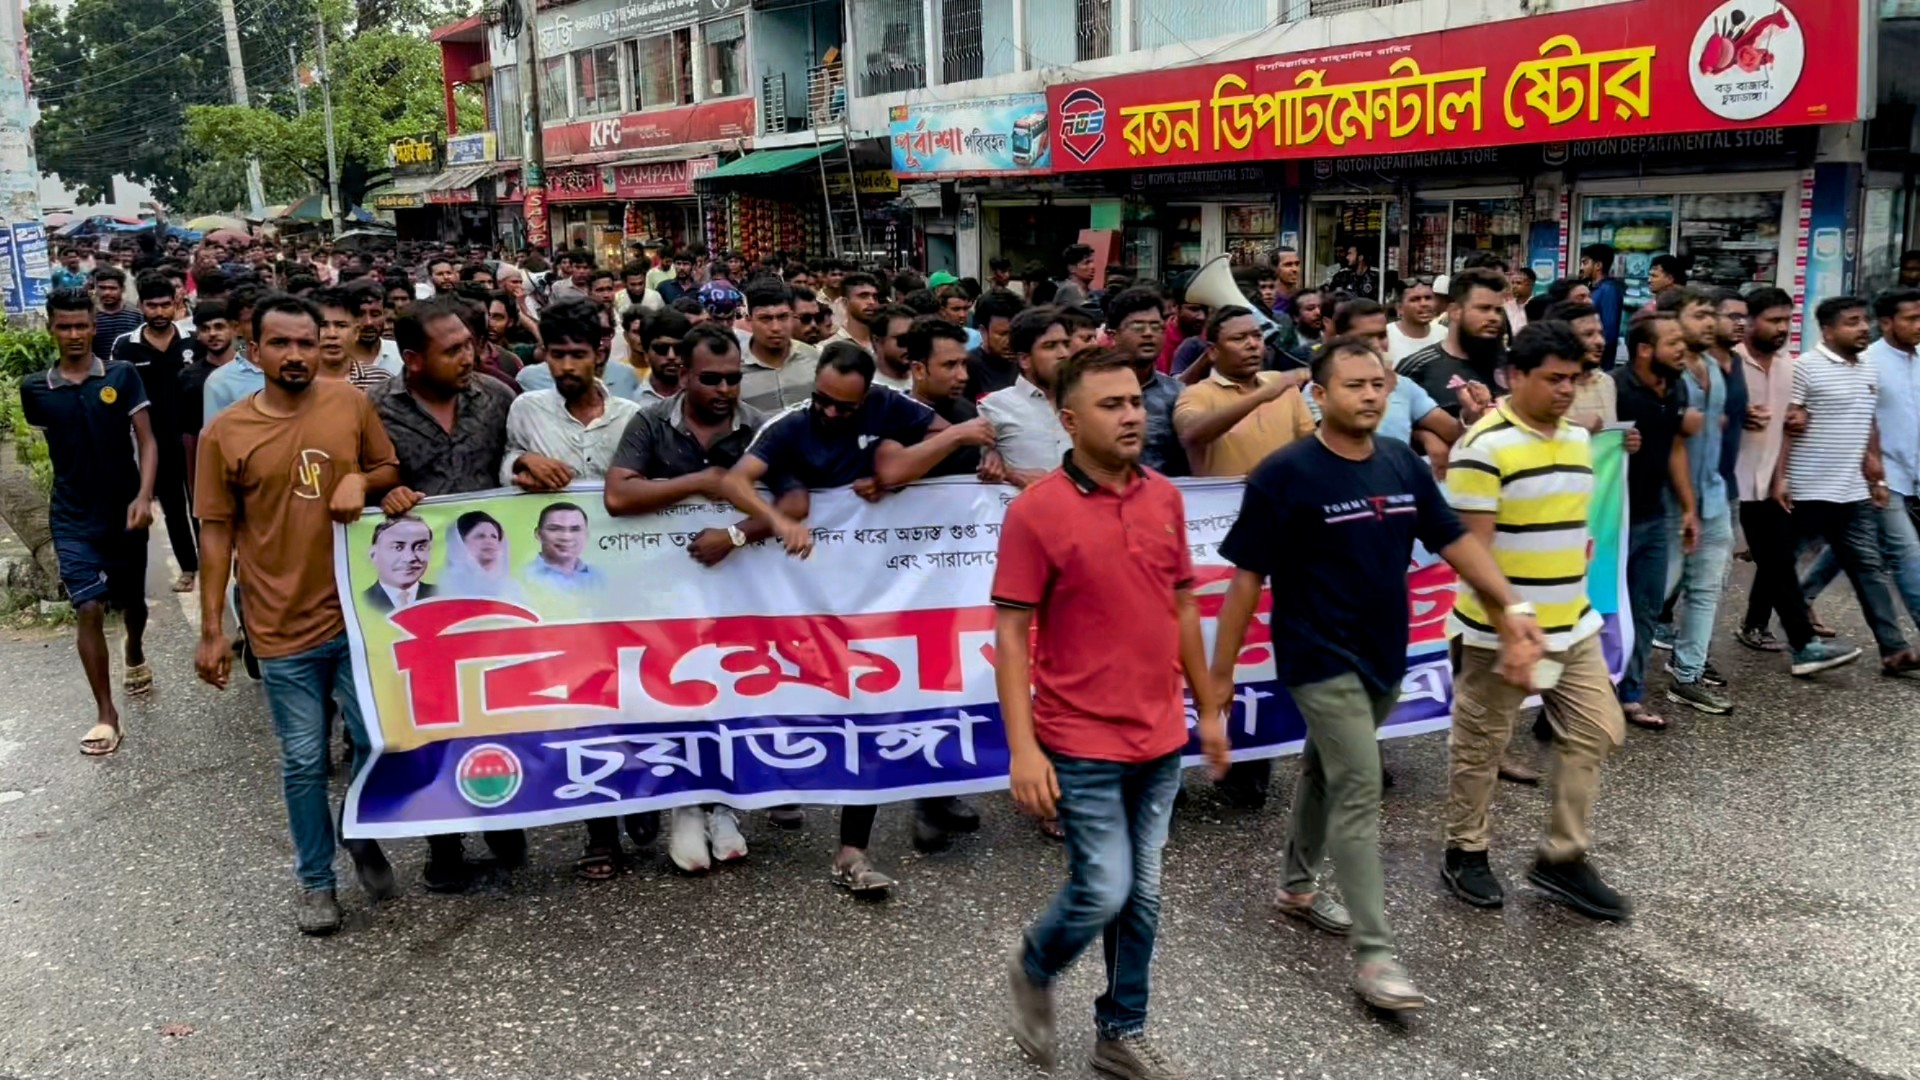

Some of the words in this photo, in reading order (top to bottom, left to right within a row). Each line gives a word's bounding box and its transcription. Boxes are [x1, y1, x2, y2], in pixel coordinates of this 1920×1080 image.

[1120, 100, 1201, 156] রতন
[1210, 57, 1487, 150] ডিপার্টমেন্টাল
[1503, 34, 1656, 128] ষ্টোর
[1715, 83, 1733, 94] বড়
[895, 119, 963, 168] পূর্বাশা
[964, 127, 1008, 155] পরিবহন
[1573, 139, 1617, 157] ROTON
[1620, 131, 1730, 155] DEPARTMENTAL
[1735, 127, 1784, 148] STORE
[1336, 158, 1372, 173] ROTON
[1373, 151, 1458, 171] DEPARTMENTAL
[1461, 148, 1498, 164] STORE
[620, 162, 686, 185] SAMPAN
[1177, 168, 1237, 184] DEPARTMENTAL
[599, 532, 662, 550] গোপন
[854, 528, 888, 544] ধরে
[886, 552, 922, 570] এবং
[387, 597, 998, 727] বিক্ষো
[541, 710, 993, 801] চুয়াডাঙ্গা
